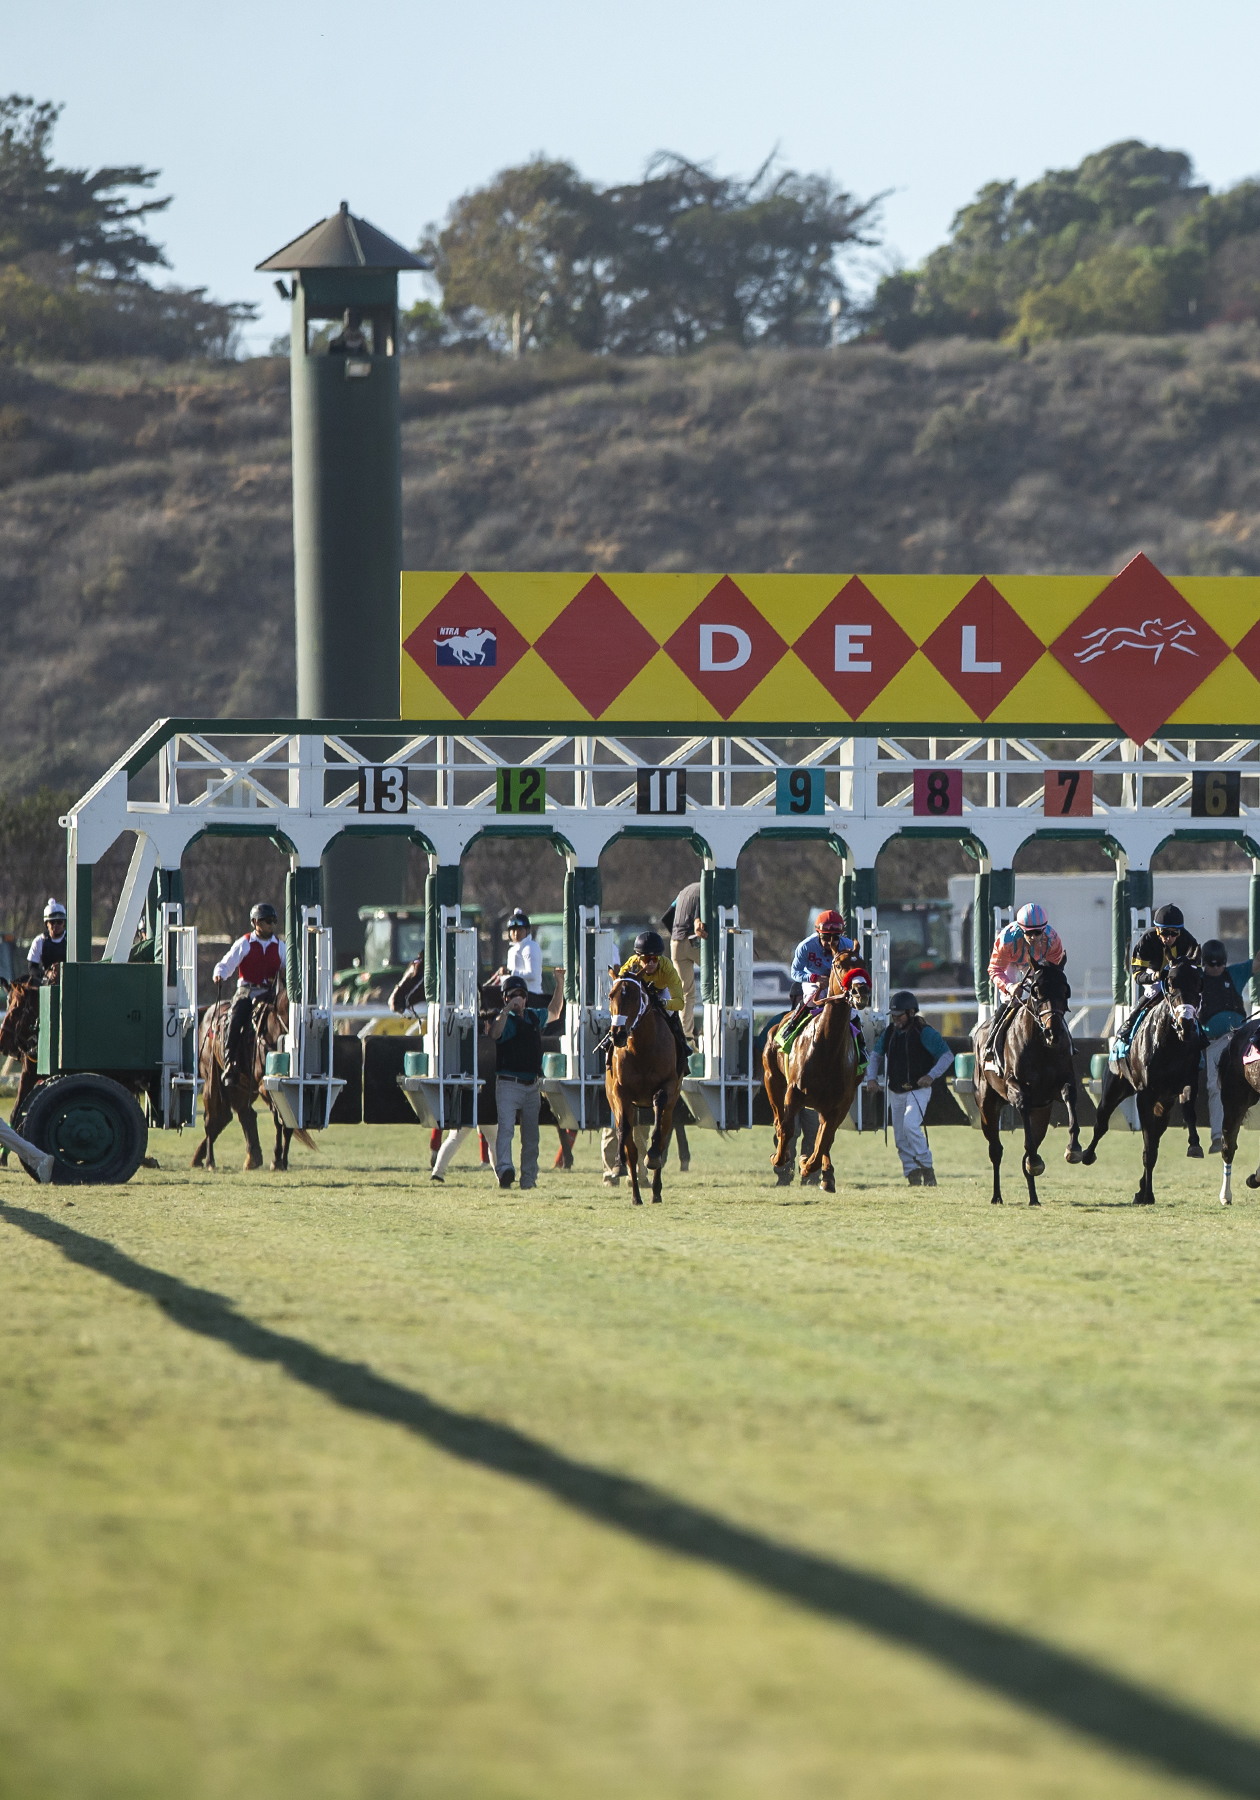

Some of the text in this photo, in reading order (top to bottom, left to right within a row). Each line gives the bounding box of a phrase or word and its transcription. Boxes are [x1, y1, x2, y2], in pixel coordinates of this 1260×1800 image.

[439, 627, 460, 636] NTRA
[699, 624, 1002, 673] DEL
[363, 767, 404, 812] 13
[501, 768, 541, 813] 12
[649, 770, 678, 812] 11
[789, 769, 812, 814] 9
[926, 771, 950, 815] 8
[1057, 771, 1080, 815] 7
[1205, 771, 1228, 816] 6
[808, 952, 822, 967] BG
